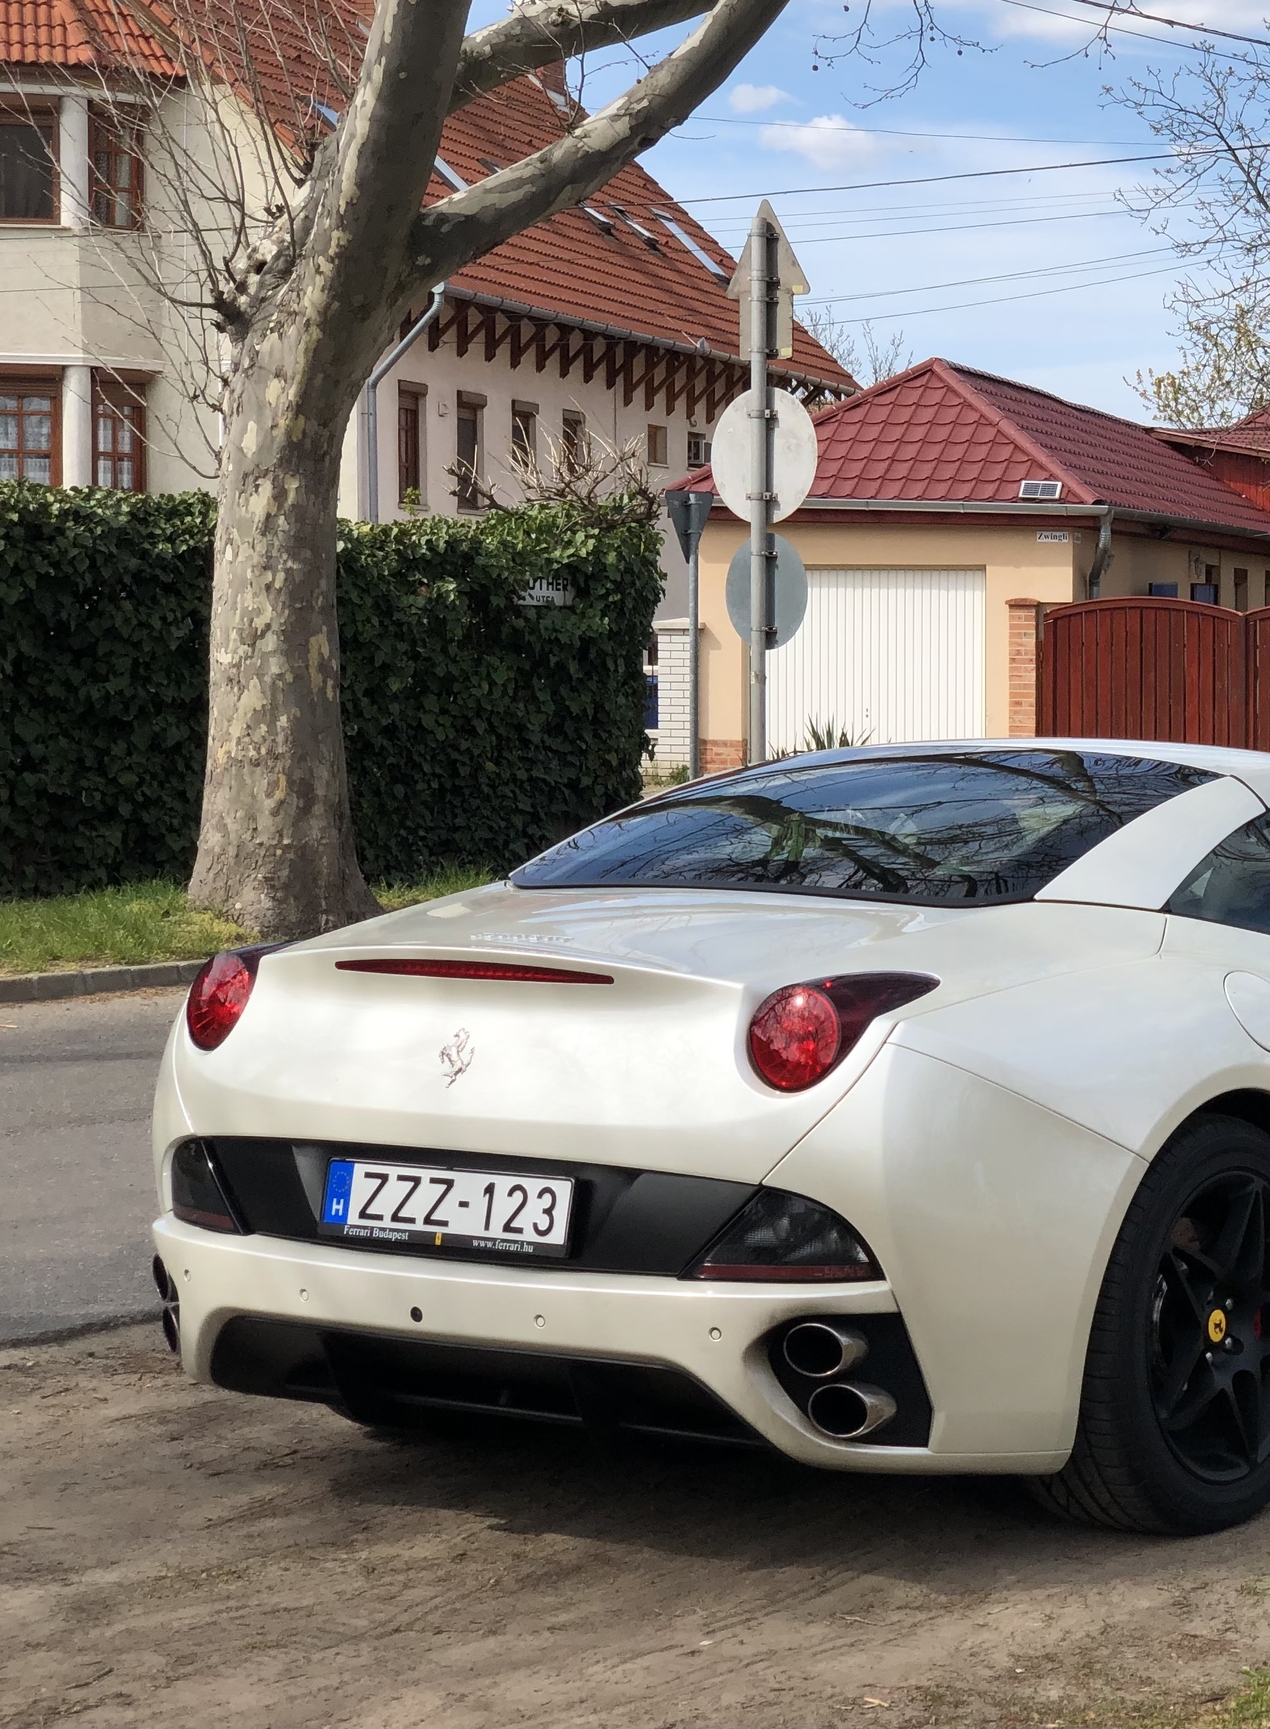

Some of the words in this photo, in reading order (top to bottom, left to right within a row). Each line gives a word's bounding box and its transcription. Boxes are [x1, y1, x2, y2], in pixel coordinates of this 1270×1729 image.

[1037, 532, 1068, 542] Zwingli
[527, 576, 569, 592] UTHER
[331, 1198, 343, 1216] H
[358, 1171, 557, 1237] ZZZ-123
[343, 1225, 371, 1237] Ferrari
[372, 1227, 409, 1241] Budapest
[472, 1238, 534, 1253] www.ferrari.hu
